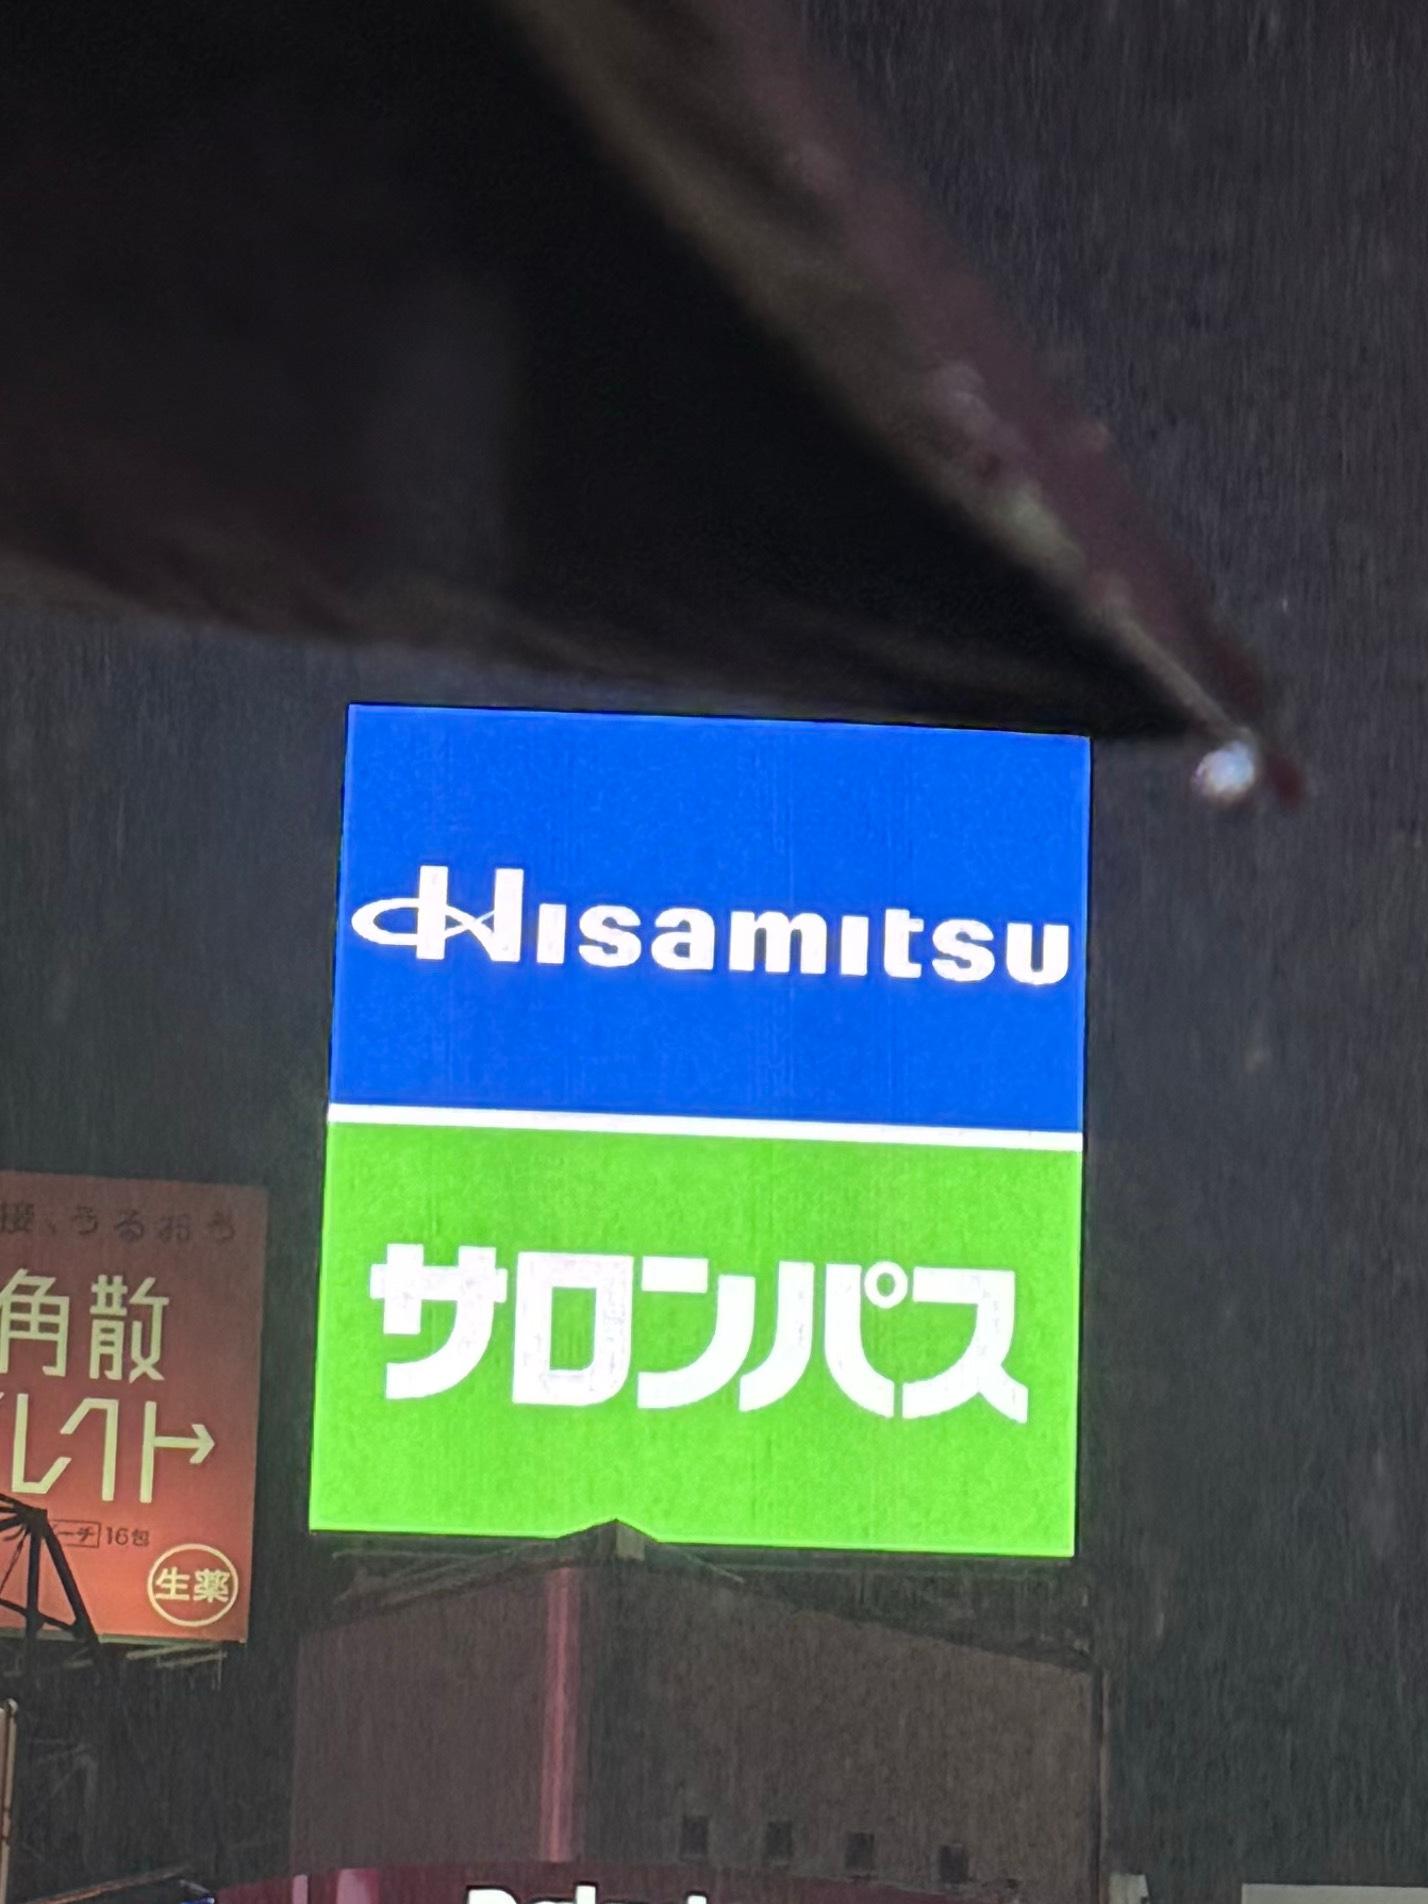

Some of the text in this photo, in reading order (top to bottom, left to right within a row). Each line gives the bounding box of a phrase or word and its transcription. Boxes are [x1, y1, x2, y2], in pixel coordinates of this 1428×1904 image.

[351, 865, 1069, 985] Hisamitsu
[369, 1243, 1028, 1424] サロンパス
[154, 1566, 231, 1605] 生薬
